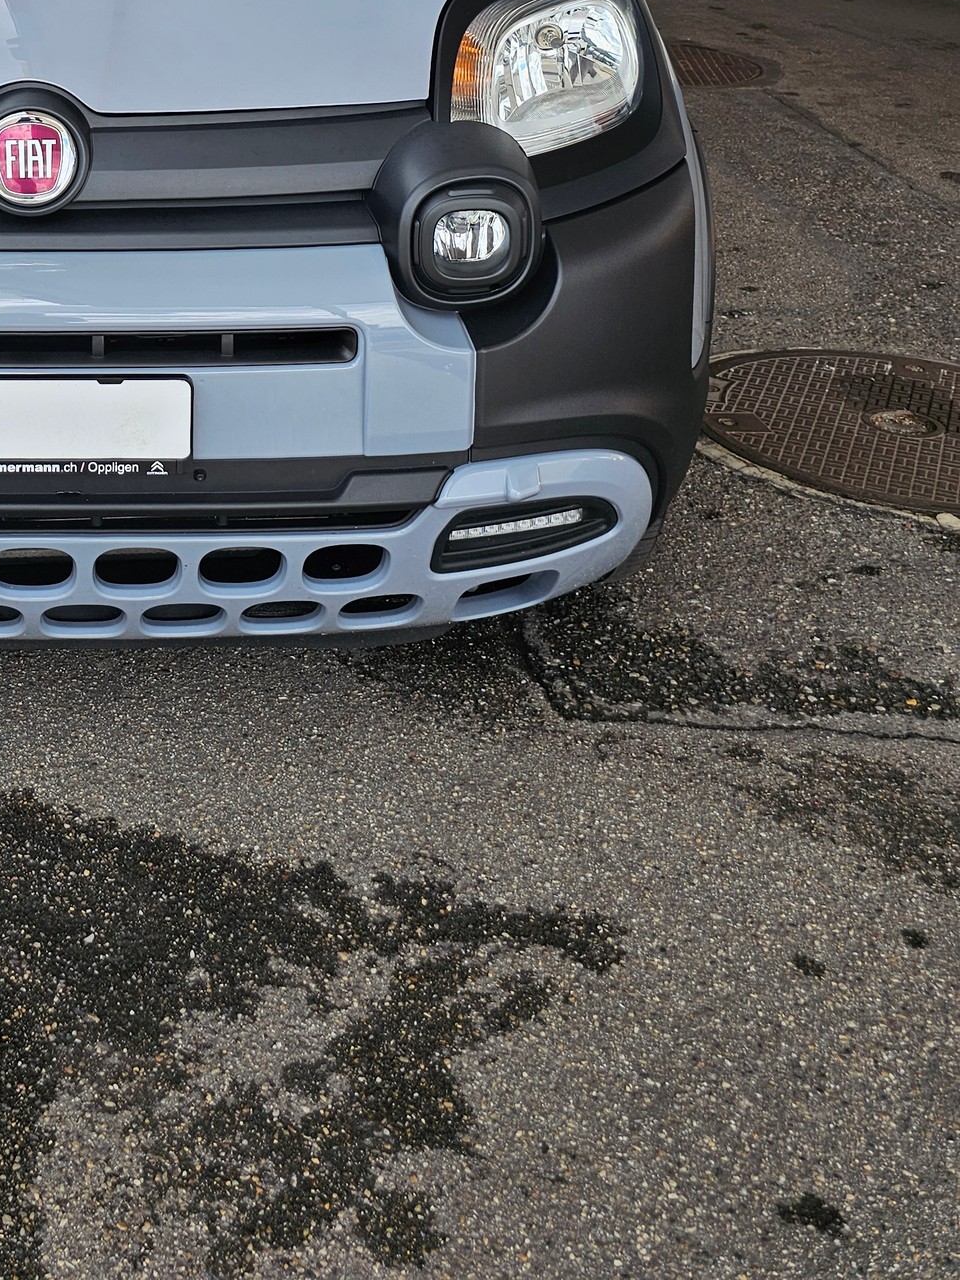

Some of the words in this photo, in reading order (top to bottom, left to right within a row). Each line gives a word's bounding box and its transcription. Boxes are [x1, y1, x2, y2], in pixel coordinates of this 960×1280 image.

[5, 139, 57, 179] FIAT
[80, 462, 86, 473] /
[87, 461, 139, 475] Oppligen
